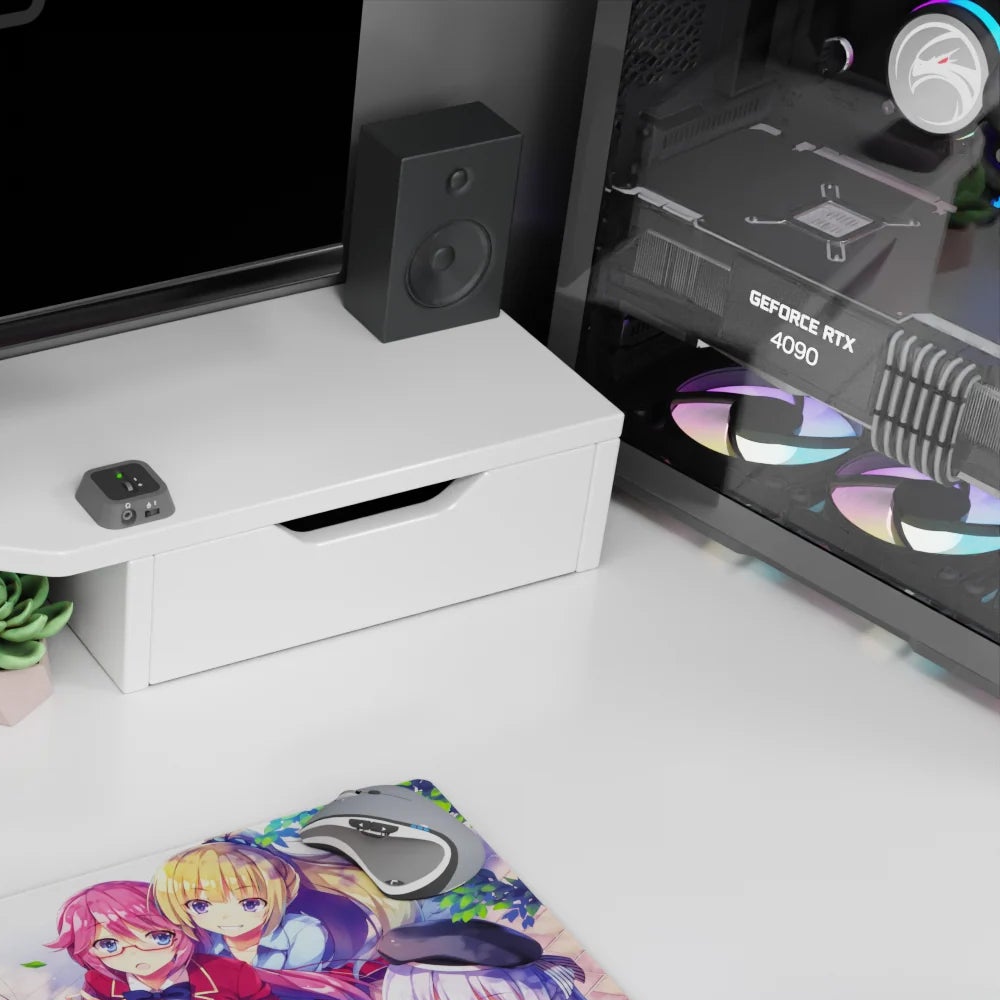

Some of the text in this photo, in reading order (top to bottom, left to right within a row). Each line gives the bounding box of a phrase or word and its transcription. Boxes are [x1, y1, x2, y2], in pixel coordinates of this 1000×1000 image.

[749, 289, 857, 354] GEFORCE RTX
[769, 331, 819, 367] 4090
